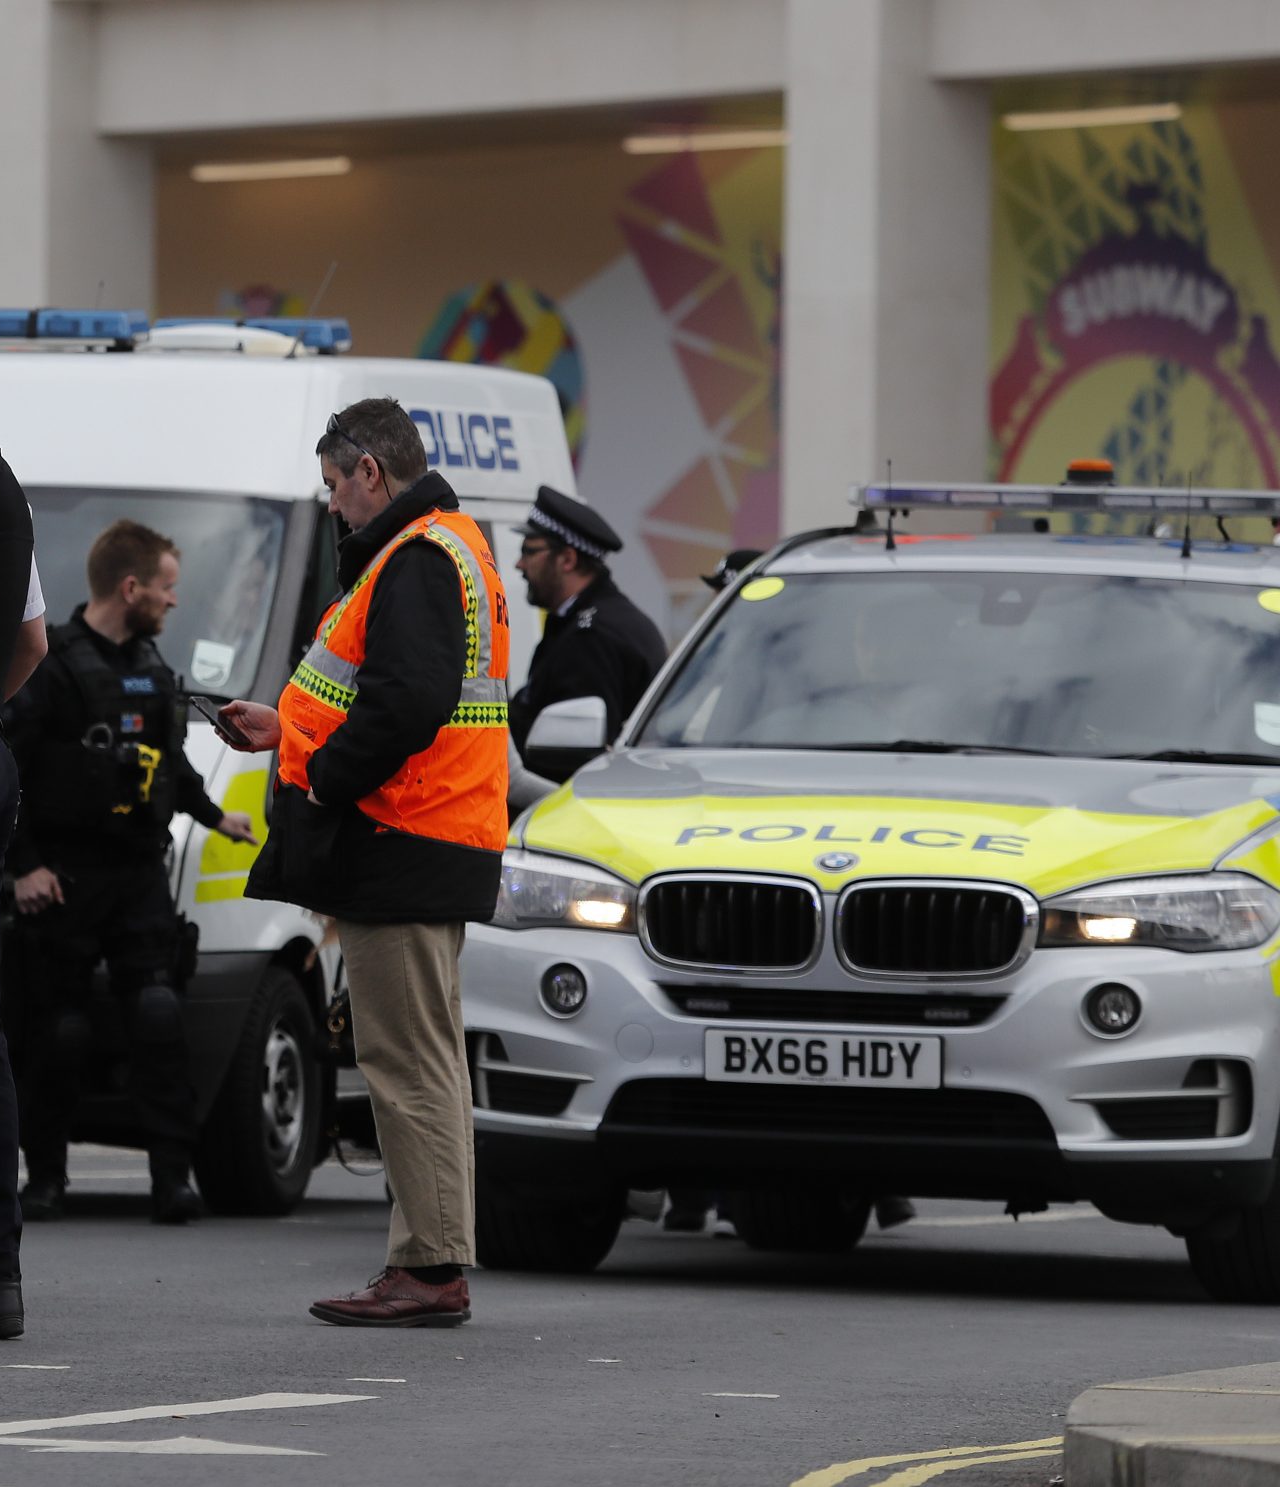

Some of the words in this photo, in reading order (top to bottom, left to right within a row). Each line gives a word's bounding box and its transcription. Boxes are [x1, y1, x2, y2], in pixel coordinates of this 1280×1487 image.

[1061, 264, 1227, 336] SUBWAY
[409, 410, 518, 470] OLICE
[674, 825, 1030, 857] POLICE
[724, 1036, 829, 1077] BX66
[842, 1040, 921, 1079] HDY
